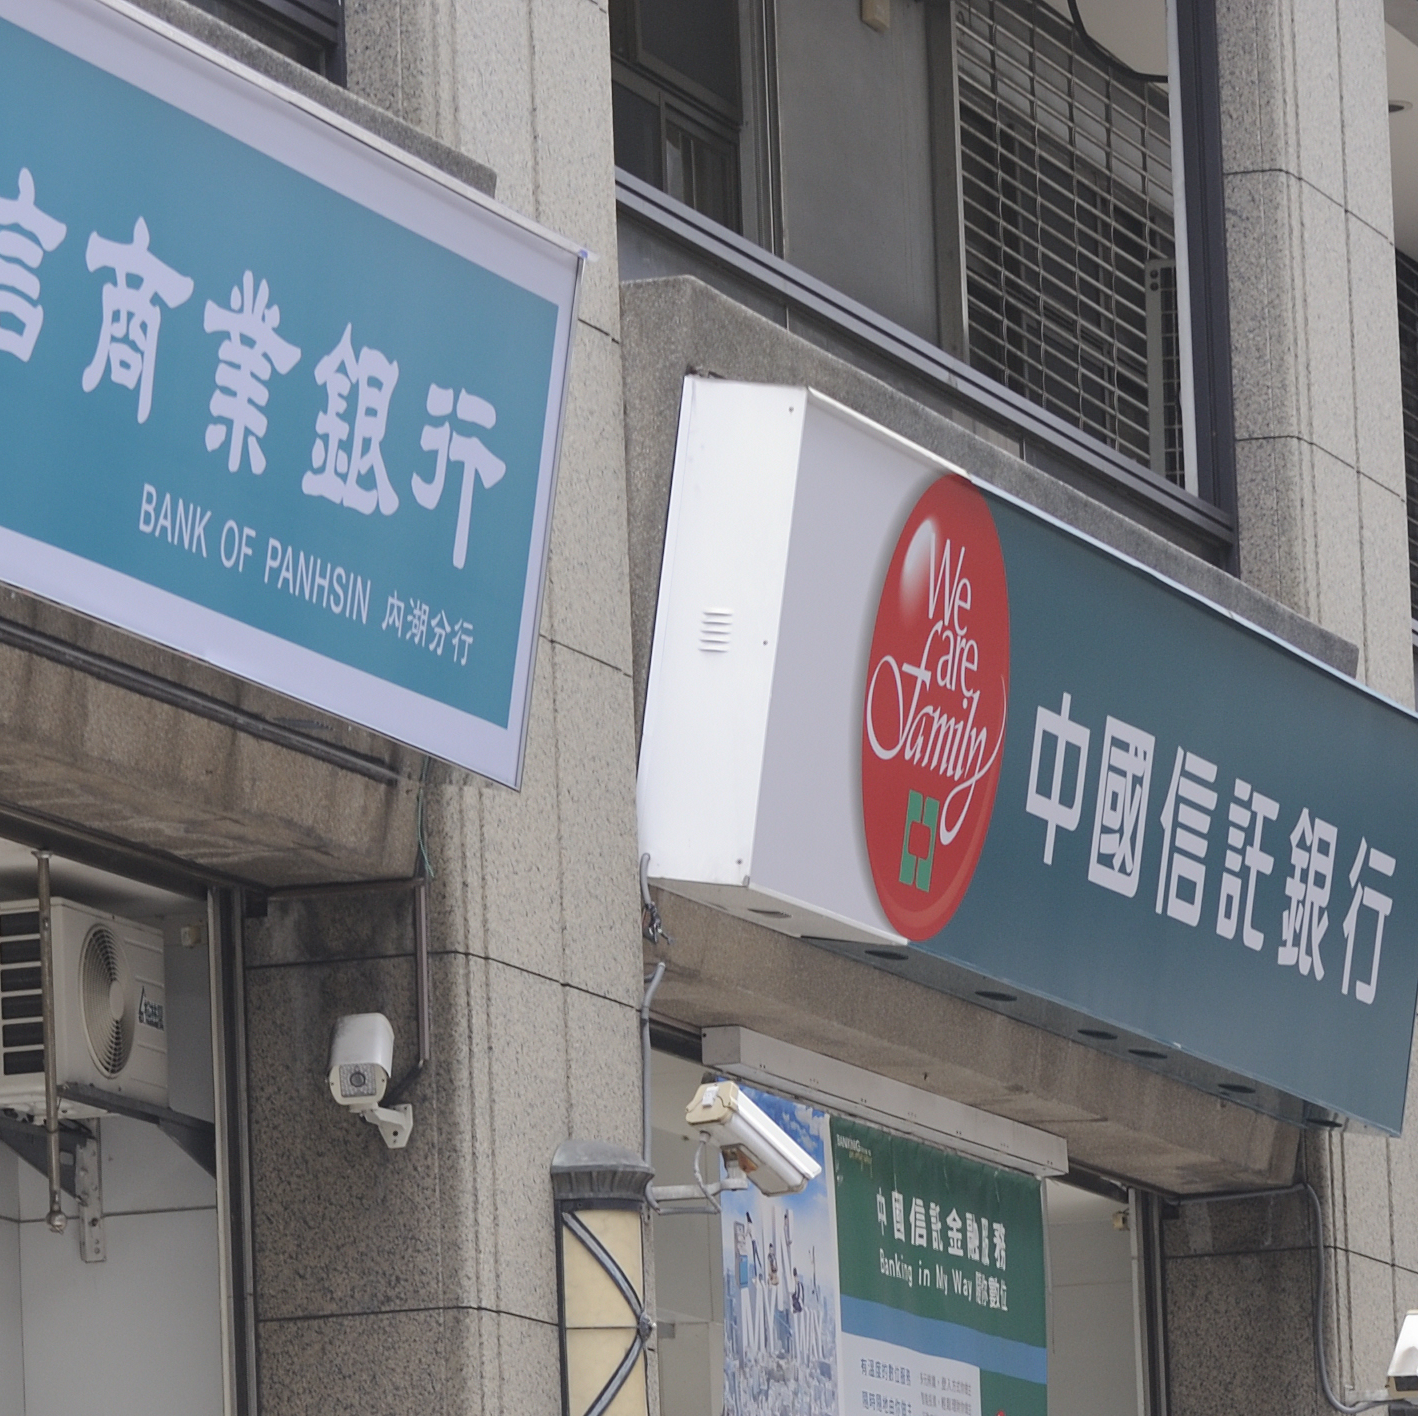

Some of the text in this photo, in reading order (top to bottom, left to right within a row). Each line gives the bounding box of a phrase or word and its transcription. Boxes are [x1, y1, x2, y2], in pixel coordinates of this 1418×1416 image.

[139, 482, 475, 668] BANK OF PANHSIN 內湖分行
[927, 537, 972, 632] We
[1025, 691, 1397, 1005] 中國信託銀行
[875, 1187, 1007, 1272] 中國信託金融服務
[879, 1247, 913, 1288] Banking
[918, 1259, 931, 1287] in
[935, 1263, 948, 1296] My
[951, 1268, 973, 1302] Way
